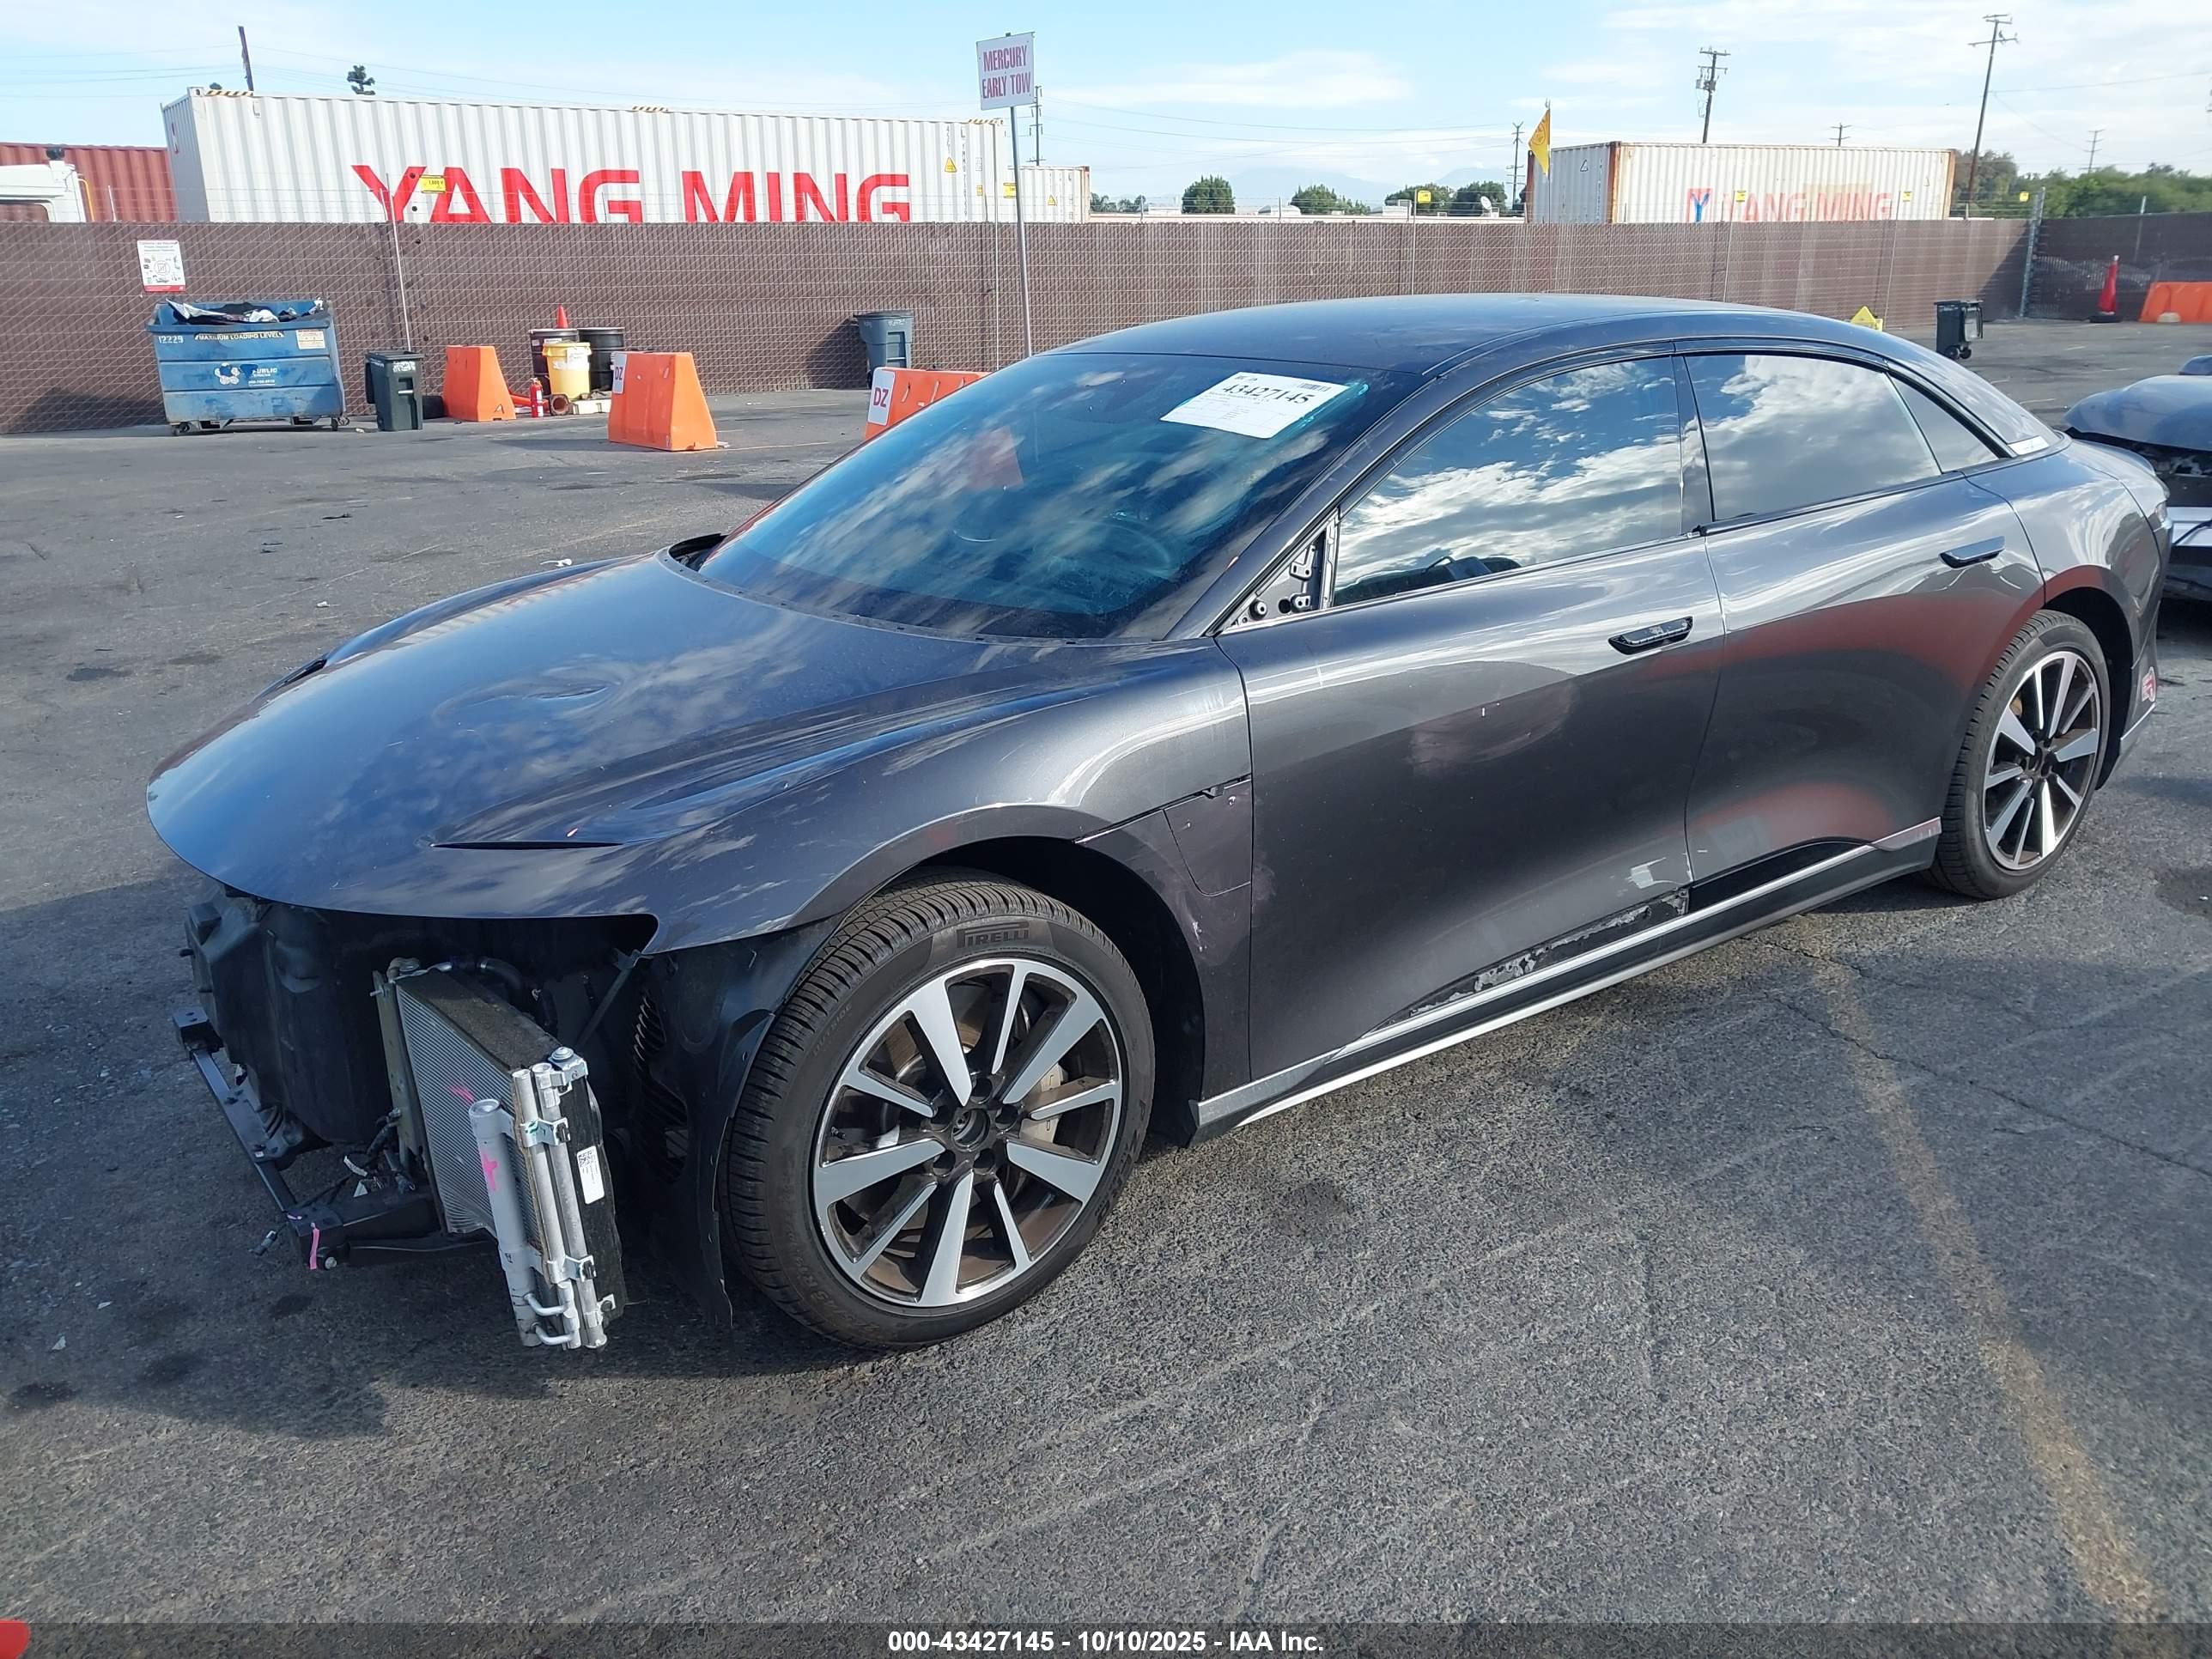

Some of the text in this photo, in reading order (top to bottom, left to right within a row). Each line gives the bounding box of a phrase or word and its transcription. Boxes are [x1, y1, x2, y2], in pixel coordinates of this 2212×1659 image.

[983, 46, 1027, 72] MERCURY
[982, 72, 1030, 99] EARLY TOW
[351, 164, 643, 223] YANG
[681, 170, 911, 223] MING
[1723, 192, 1893, 222] YANG MING
[231, 331, 259, 340] LOADING
[615, 366, 624, 380] DZ
[873, 386, 890, 408] DZ
[1223, 384, 1315, 404] 43427145
[956, 921, 1030, 949] PIRELLI
